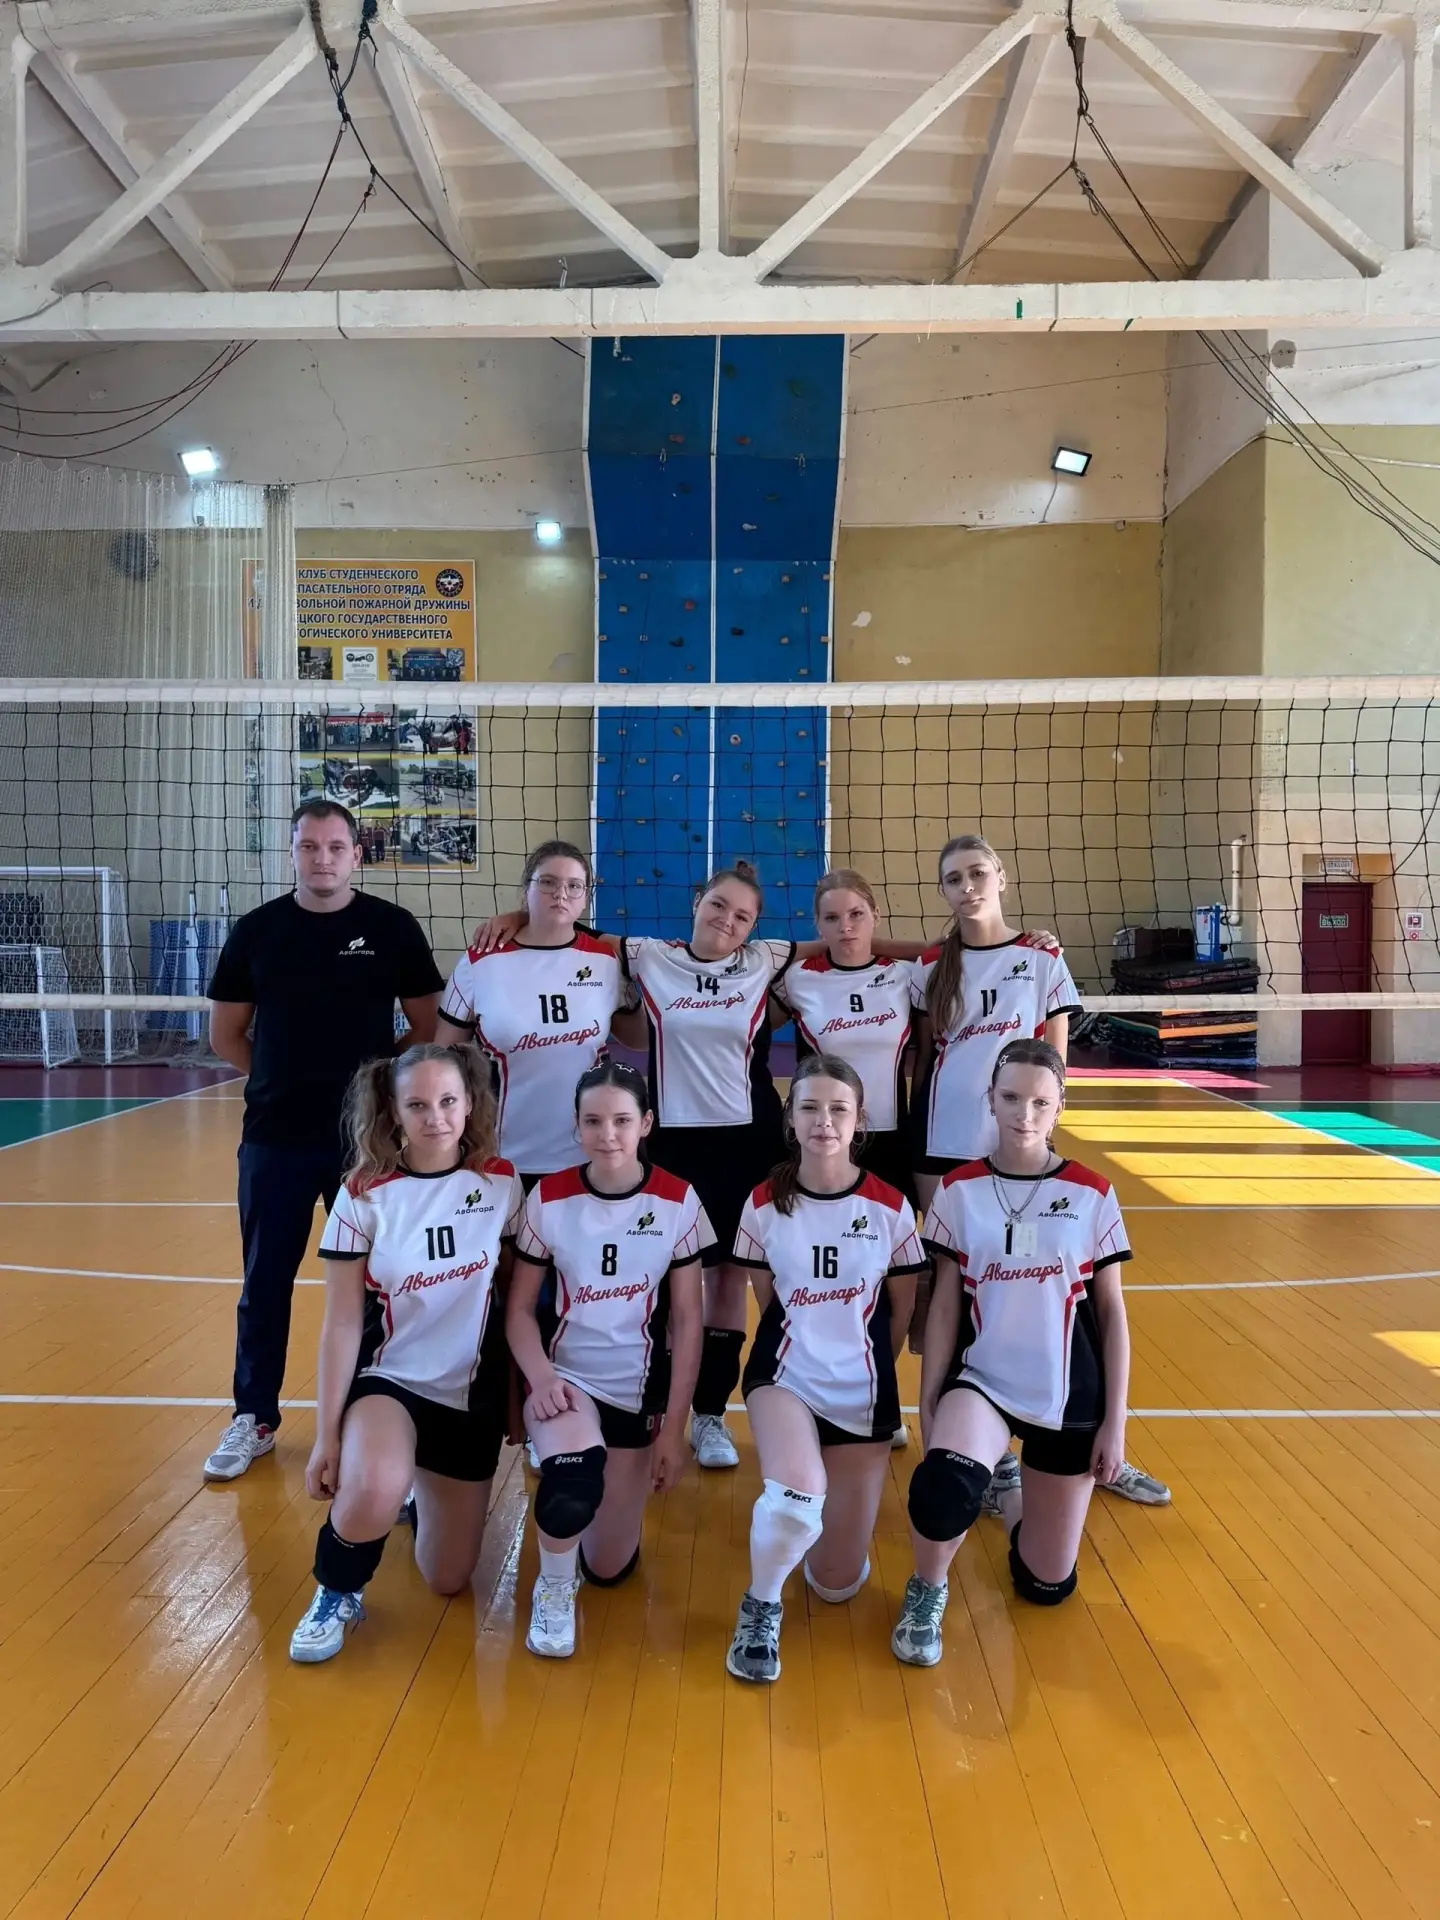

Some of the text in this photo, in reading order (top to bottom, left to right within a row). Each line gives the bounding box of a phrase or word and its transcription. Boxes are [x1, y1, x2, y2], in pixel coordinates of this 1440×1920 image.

[298, 569, 419, 581] КЛУБ СТУДЕНЧЕСКОГО
[296, 584, 426, 596] ПАСАТЕЛЬНОГО ОТРЯДА
[349, 597, 411, 610] ПОЖАРНОЙ
[414, 600, 470, 611] ДРУЖИНЫ
[295, 614, 448, 625] ЕЦКОГО ГОСУДАРСТВЕННОГО
[297, 629, 453, 640] ОГИЧЕСКОГО УНИВЕРСИТЕТА
[696, 974, 720, 996] 14
[538, 994, 570, 1024] 18
[665, 991, 746, 1011] Авангард
[849, 993, 864, 1013] 9
[981, 989, 997, 1017] 11
[818, 1007, 898, 1036] Авангард
[509, 1019, 602, 1054] Авангард
[455, 1205, 495, 1216] Авангард
[1038, 1211, 1079, 1221] Авангард
[425, 1225, 456, 1261] 10
[841, 1231, 879, 1241] Авангард
[1005, 1222, 1013, 1255] 1
[393, 1250, 489, 1297] Авангард
[601, 1243, 618, 1276] 8
[812, 1245, 839, 1279] 16
[978, 1256, 1064, 1284] Авангард
[573, 1273, 650, 1304] Авангард
[785, 1277, 866, 1308] Авангард
